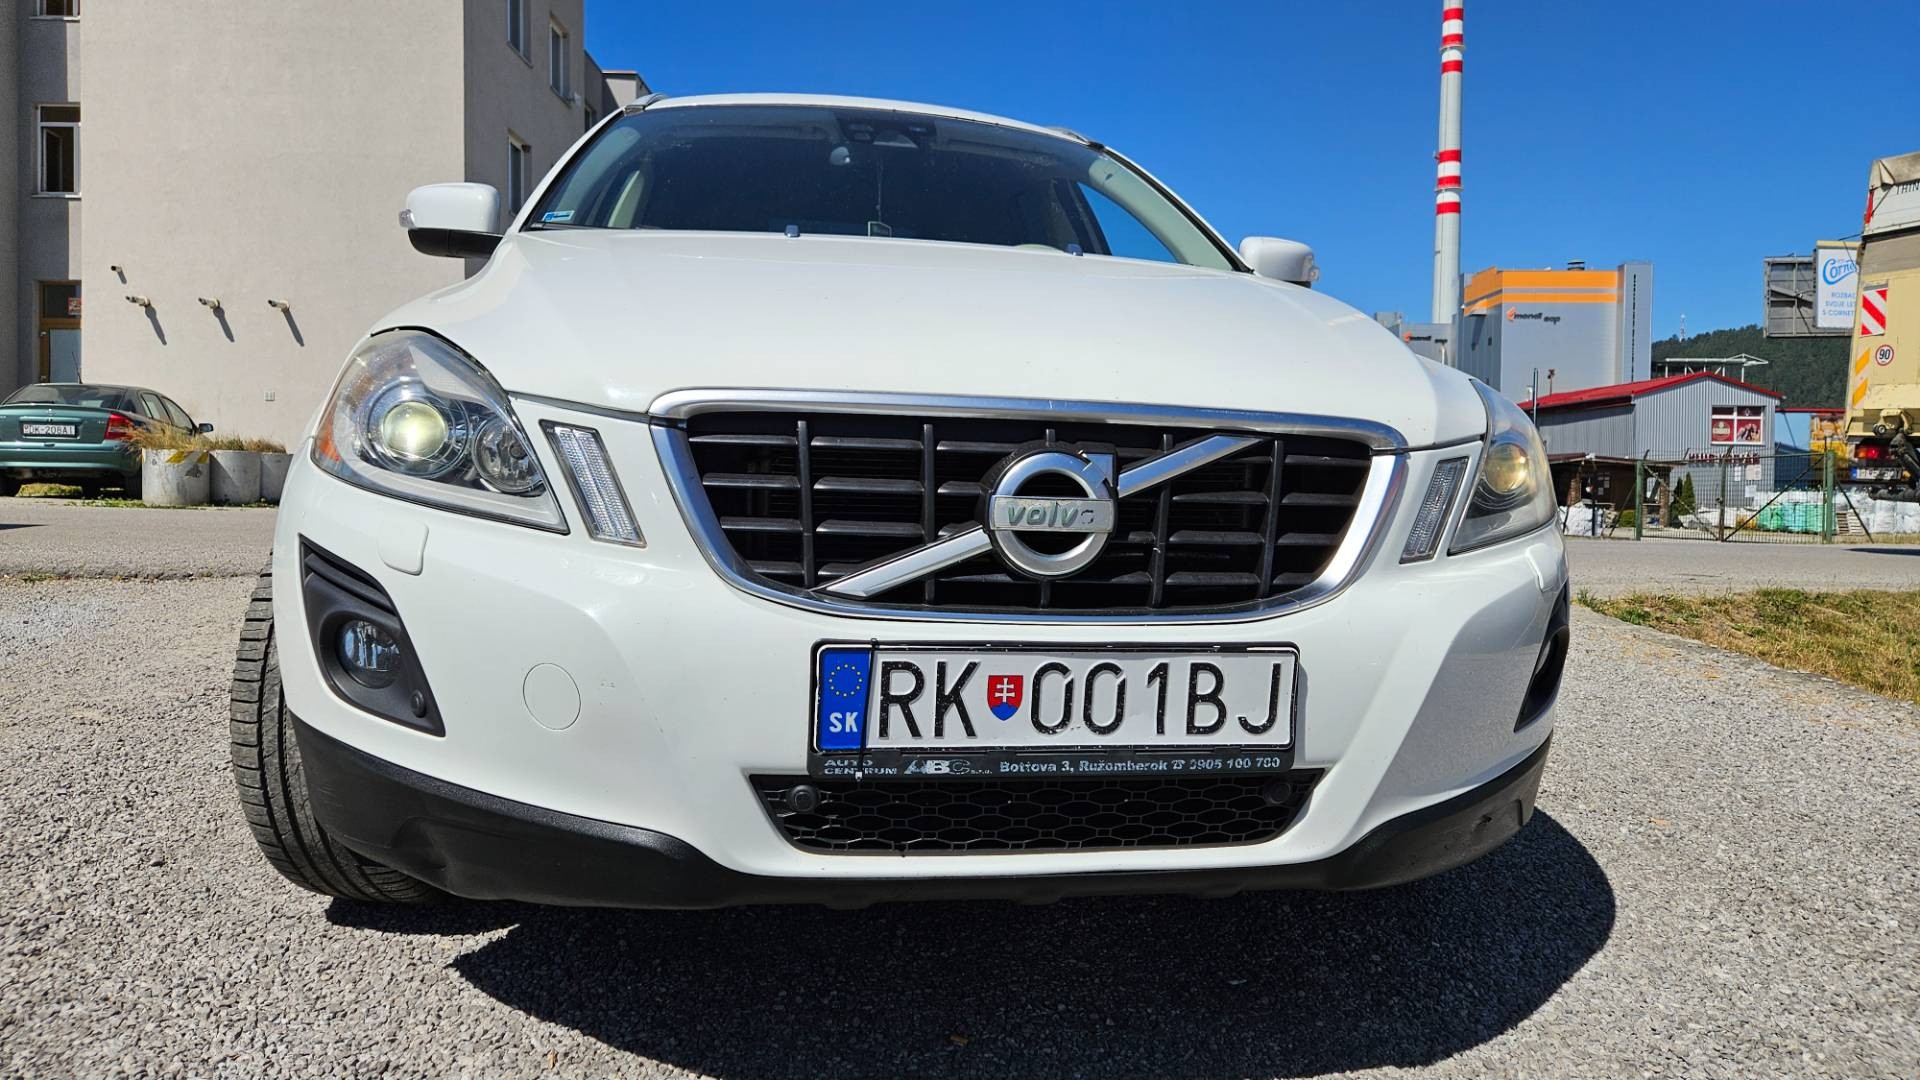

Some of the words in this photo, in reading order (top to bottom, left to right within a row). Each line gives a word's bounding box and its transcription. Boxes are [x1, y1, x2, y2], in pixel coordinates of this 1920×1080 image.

[1879, 348, 1891, 360] 90
[828, 711, 859, 734] SK
[1226, 758, 1251, 769] 100
